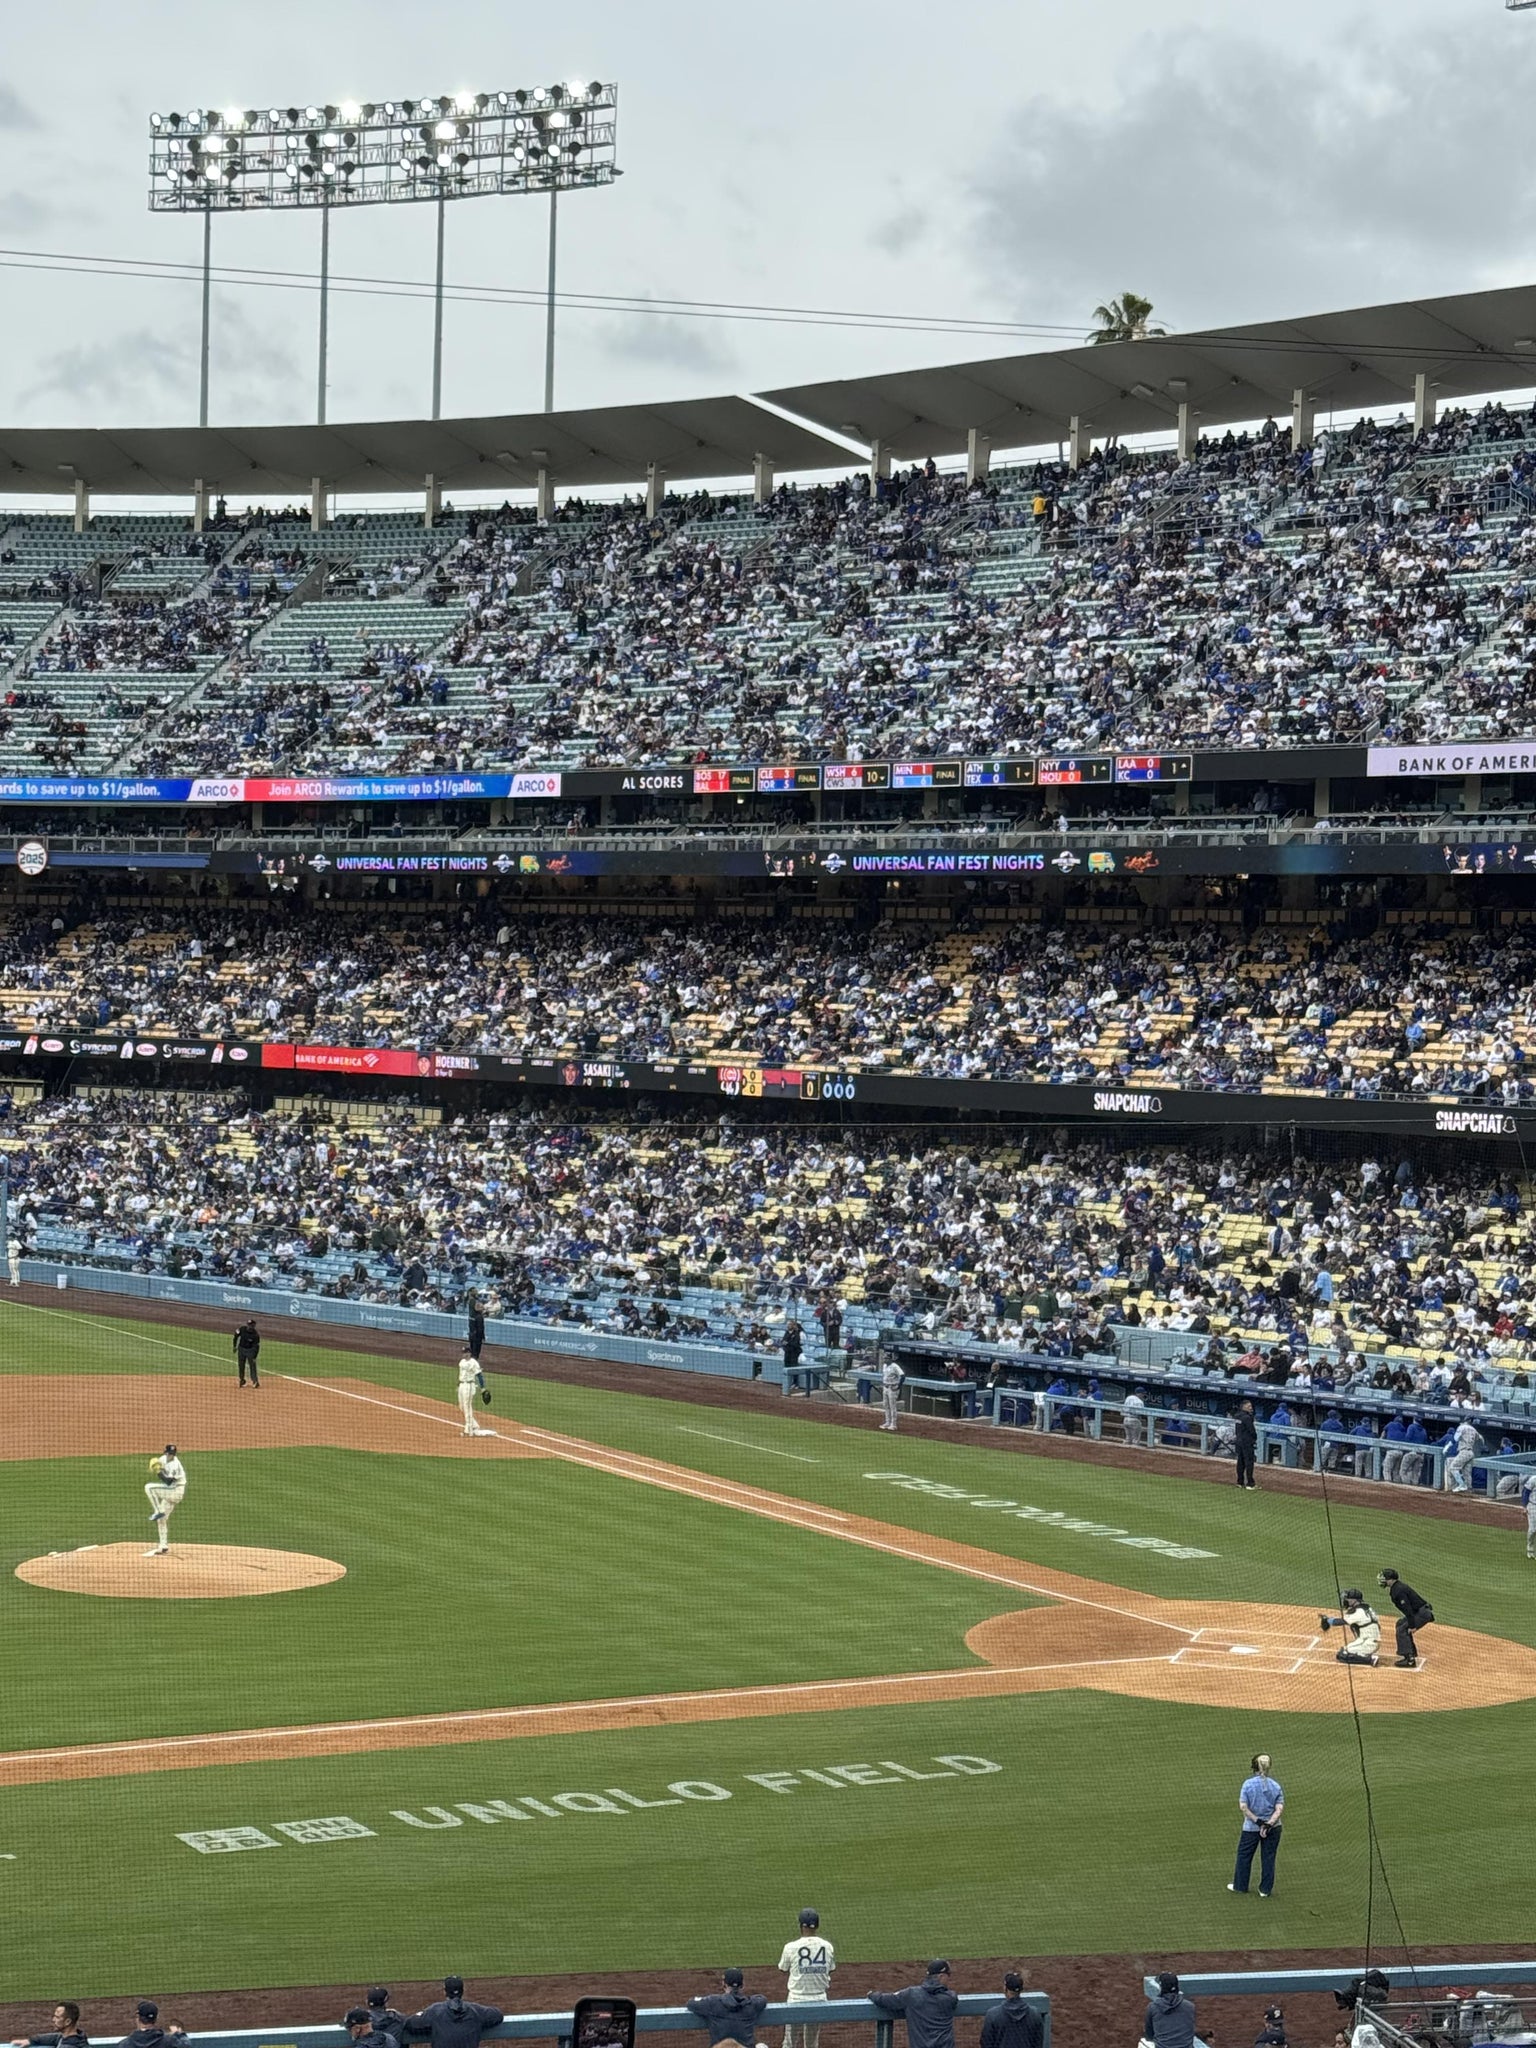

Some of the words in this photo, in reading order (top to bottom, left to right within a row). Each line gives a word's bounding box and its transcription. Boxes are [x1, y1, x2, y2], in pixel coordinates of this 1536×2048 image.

[966, 764, 984, 774] ATH
[993, 763, 1000, 773] 0
[1041, 761, 1060, 771] NYY
[1069, 761, 1076, 770] 0
[1118, 760, 1138, 769] LAA
[1147, 758, 1154, 768] 0
[1172, 762, 1177, 774] 1
[1398, 758, 1446, 772] BANK
[1451, 757, 1474, 770] OF
[695, 771, 712, 780] BOS
[760, 769, 774, 779] CLE
[784, 769, 790, 779] 3
[826, 768, 846, 777] WSH
[851, 767, 857, 777] 6
[895, 765, 913, 775] MIN
[936, 771, 956, 779] FINAL
[1016, 767, 1021, 779] 1
[1092, 765, 1097, 777] 1
[1118, 770, 1130, 780] KC
[1147, 770, 1154, 779] 0
[622, 777, 636, 789] AL
[639, 776, 683, 789] SCORES
[731, 776, 751, 785] FINAL
[798, 774, 817, 783] FINAL
[867, 771, 878, 783] 10
[966, 774, 981, 784] TEX
[993, 774, 1000, 783] 0
[1040, 772, 1061, 782] HOU
[1068, 772, 1075, 781] 0
[26, 783, 38, 795] to
[41, 785, 68, 795] save
[70, 785, 85, 797] up
[87, 784, 99, 795] to
[102, 782, 160, 798] $1/gallon.
[197, 785, 228, 796] ARCO
[268, 783, 292, 796] Join
[294, 783, 322, 795] ARCO
[324, 782, 369, 795] Rewards
[371, 783, 381, 795] to
[383, 783, 406, 795] save
[408, 785, 420, 797] up
[422, 782, 431, 794] to
[434, 780, 485, 796] $1/gallon.
[517, 780, 545, 792] ARCO
[760, 780, 775, 789] TOR
[20, 852, 45, 865] 2025
[337, 857, 395, 870] UNIVERSAL
[397, 857, 418, 870] FAN
[420, 857, 447, 870] FEST
[449, 857, 488, 870] NIGHTS
[852, 856, 925, 871] UNIVERSAL
[927, 856, 956, 870] FAN
[958, 856, 989, 870] FEST
[992, 855, 1045, 870] NIGHTS
[295, 1054, 316, 1063] BANK
[317, 1056, 327, 1064] OF
[327, 1056, 362, 1066] AMERICA
[435, 1056, 470, 1070] HOERNER
[583, 1063, 611, 1077] SASAKI
[750, 1071, 756, 1081] 0
[750, 1084, 756, 1094] 0
[807, 1081, 814, 1097] 0
[1094, 1092, 1151, 1113] SNAPCHAT
[1435, 1111, 1504, 1134] SNAPCHAT
[647, 1350, 684, 1363] Spectrum
[1186, 1397, 1208, 1410] blue
[862, 1473, 989, 1499] FIELD
[970, 1500, 1129, 1536] UNIQLO
[389, 1780, 733, 1829] UNIQLO
[743, 1755, 1003, 1793] FIELD
[286, 1819, 347, 1832] UNI
[300, 1827, 365, 1841] QLO
[798, 1946, 826, 1966] 84
